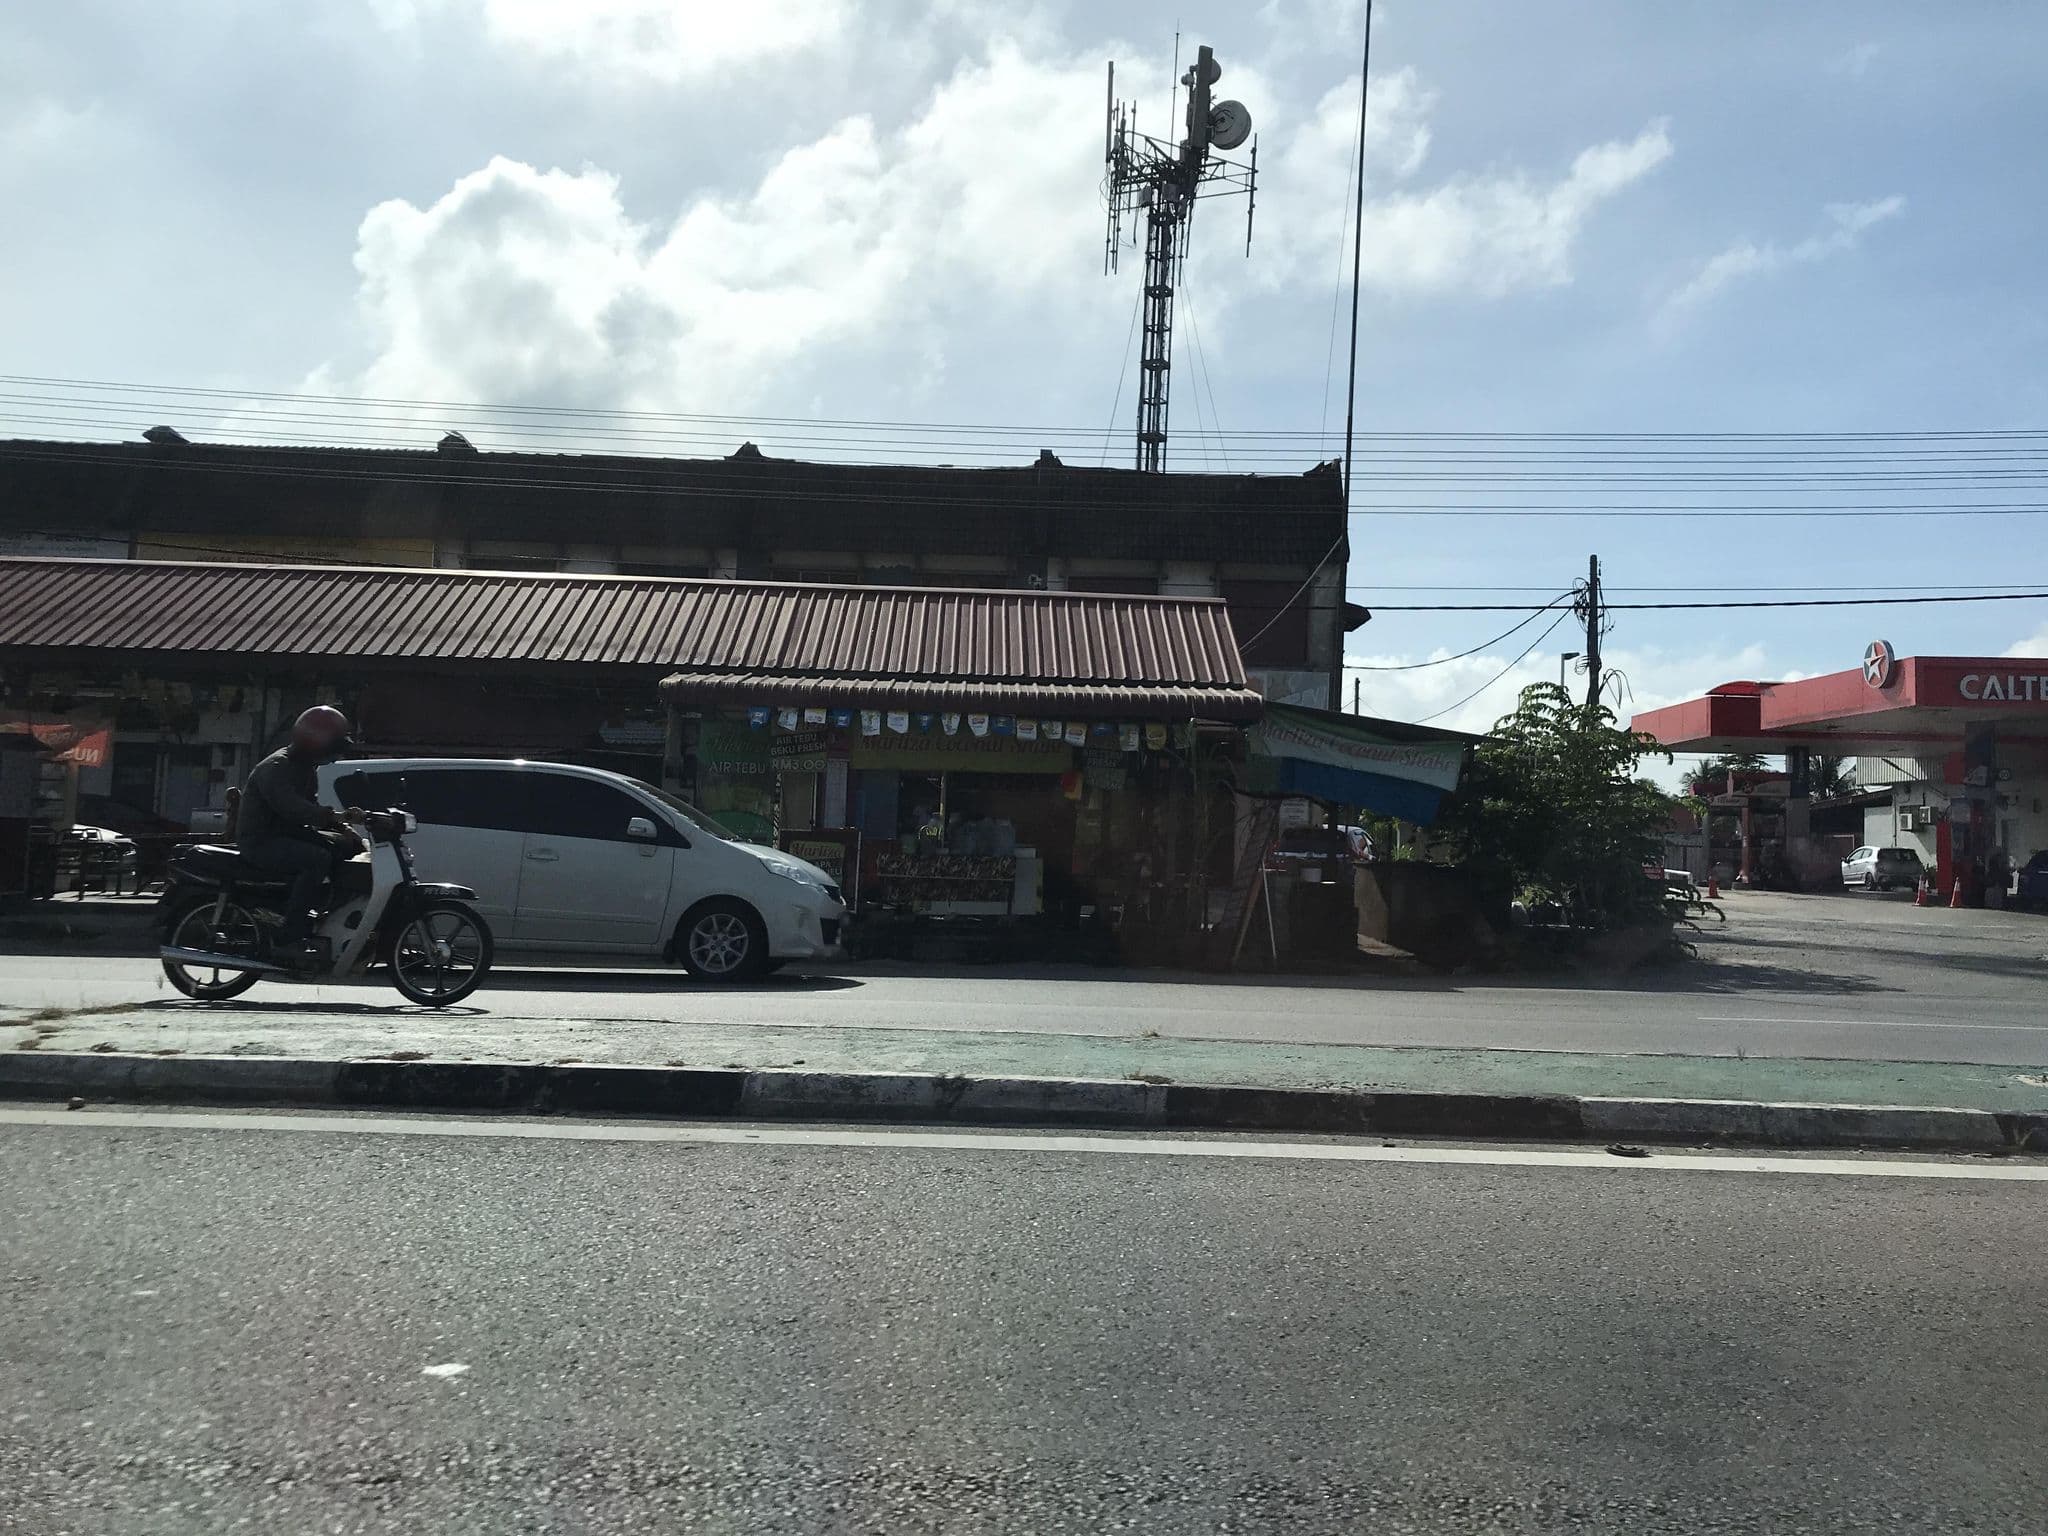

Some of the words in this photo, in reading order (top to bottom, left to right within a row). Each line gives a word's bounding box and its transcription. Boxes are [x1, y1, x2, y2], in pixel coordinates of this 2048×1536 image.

[776, 735, 792, 745] AIR
[793, 733, 817, 743] TEBU
[797, 741, 826, 753] FRESH
[709, 761, 731, 773] AIR
[734, 761, 766, 775] TEBU
